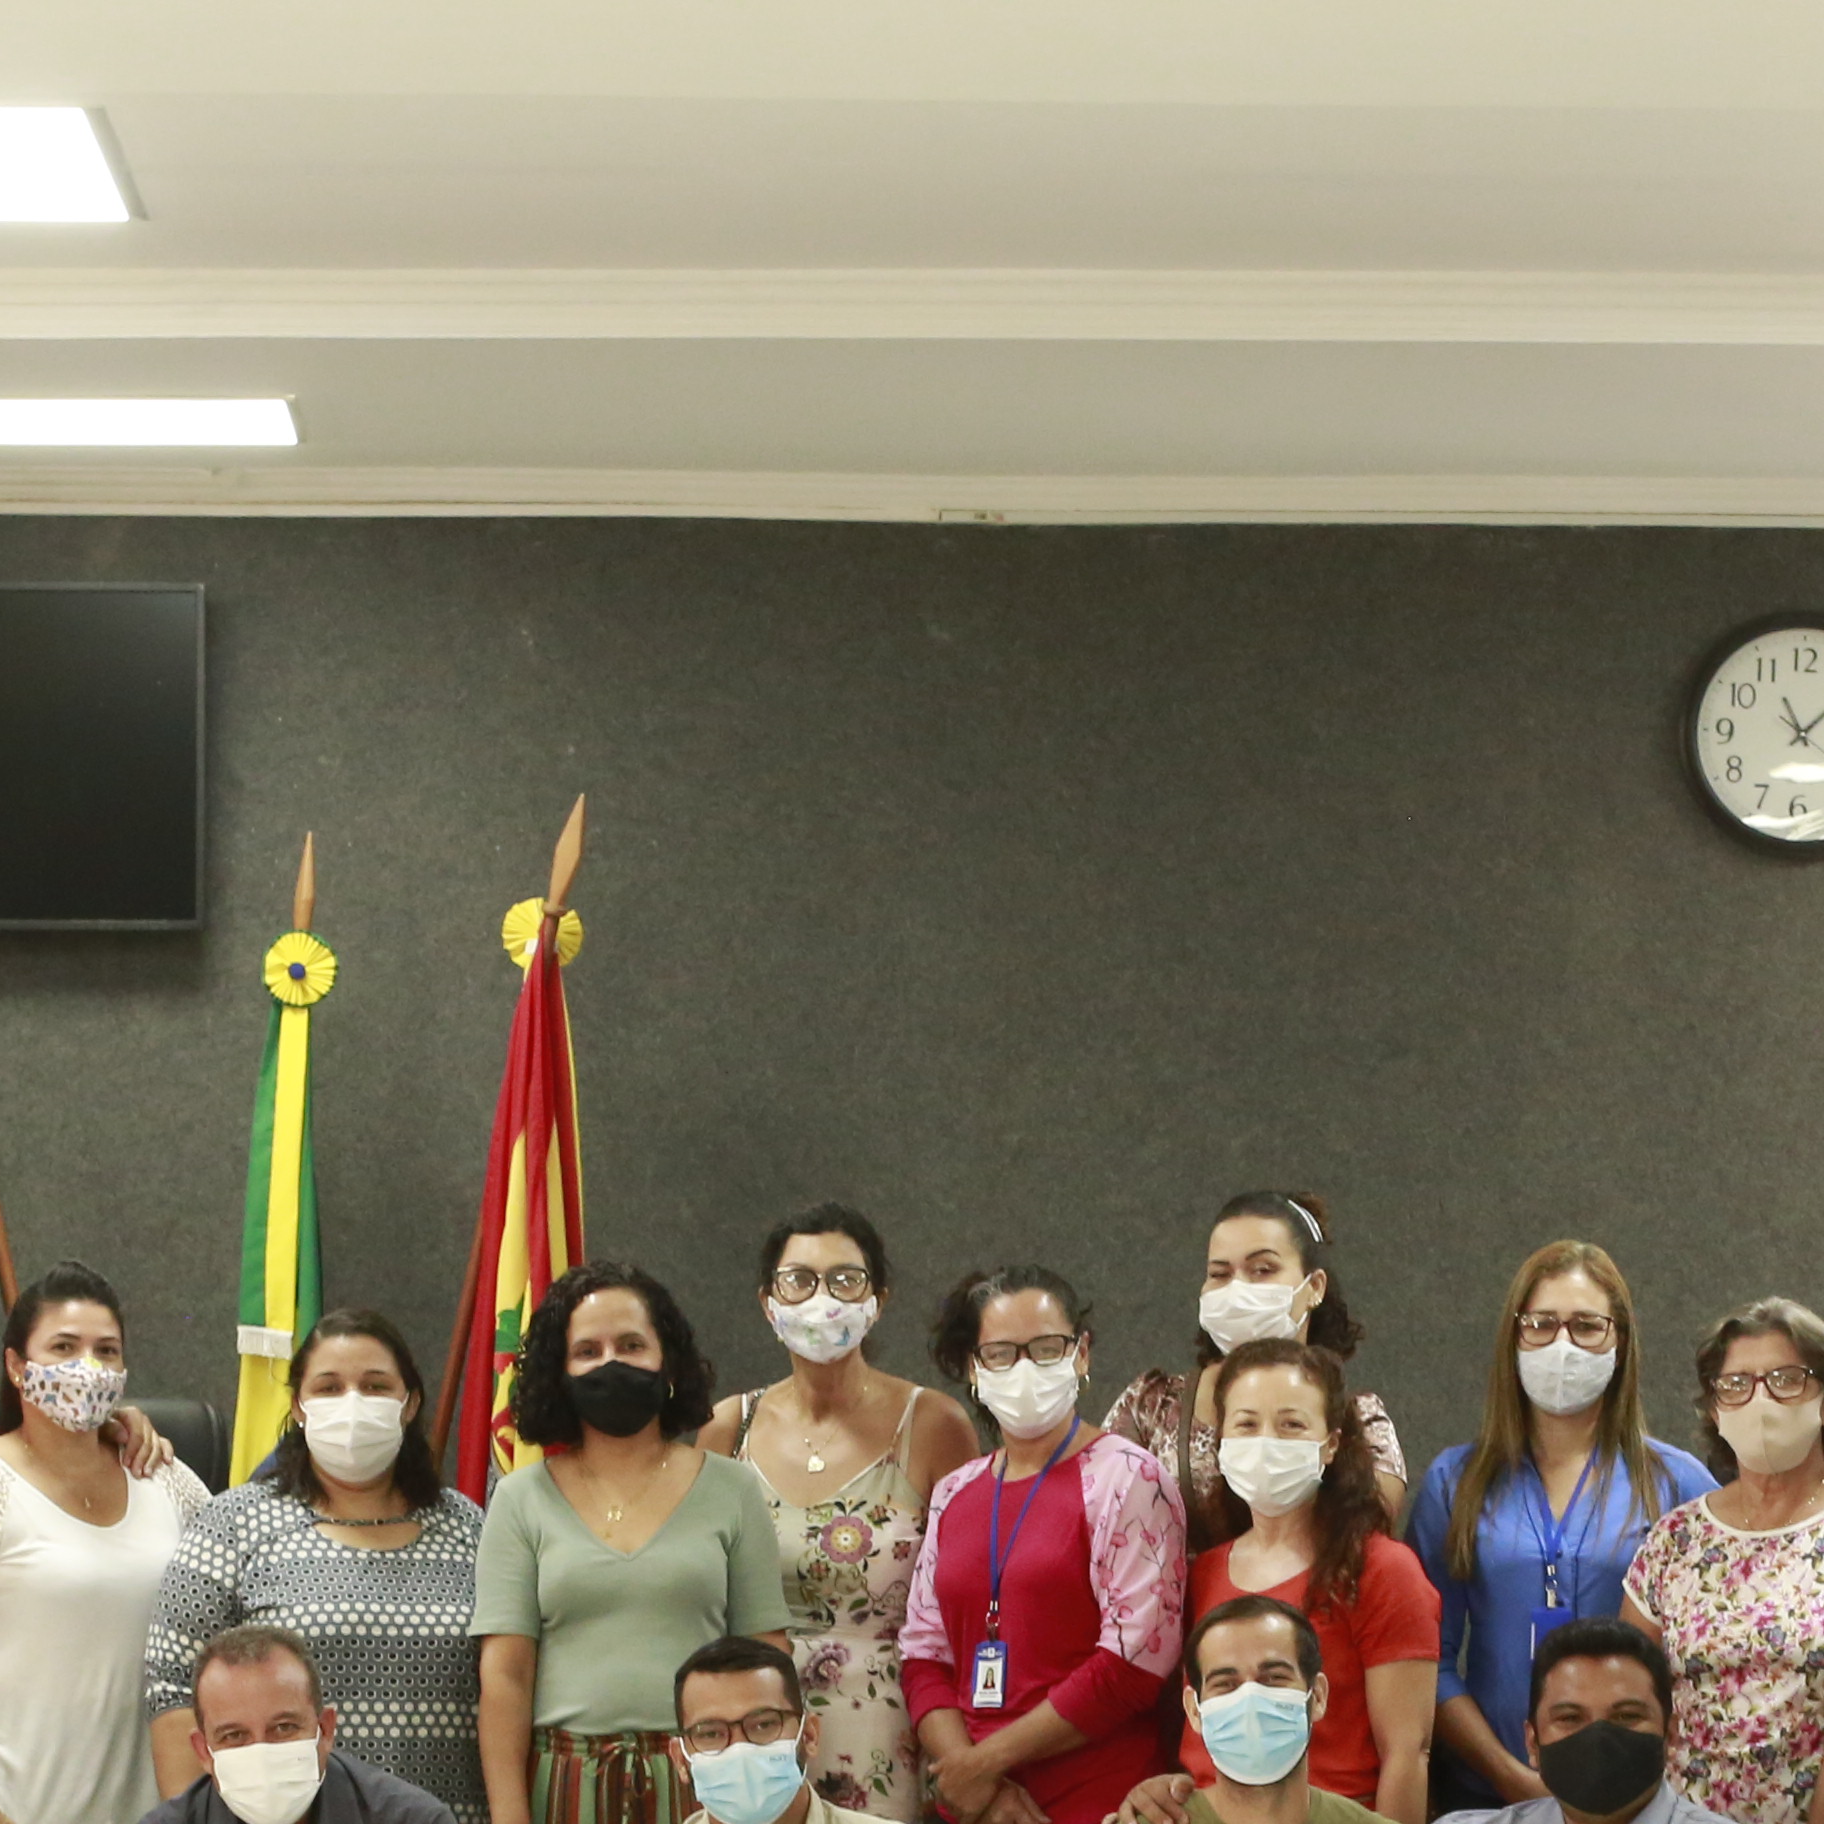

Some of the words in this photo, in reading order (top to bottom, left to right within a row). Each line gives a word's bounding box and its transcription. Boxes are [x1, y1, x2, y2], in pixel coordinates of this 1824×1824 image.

[1756, 657, 1776, 683] 11
[1793, 647, 1818, 673] 12
[1731, 682, 1756, 709] 10
[1715, 718, 1734, 744] 9
[1726, 755, 1742, 783] 8
[1754, 784, 1770, 810] 7
[1789, 794, 1808, 818] 6
